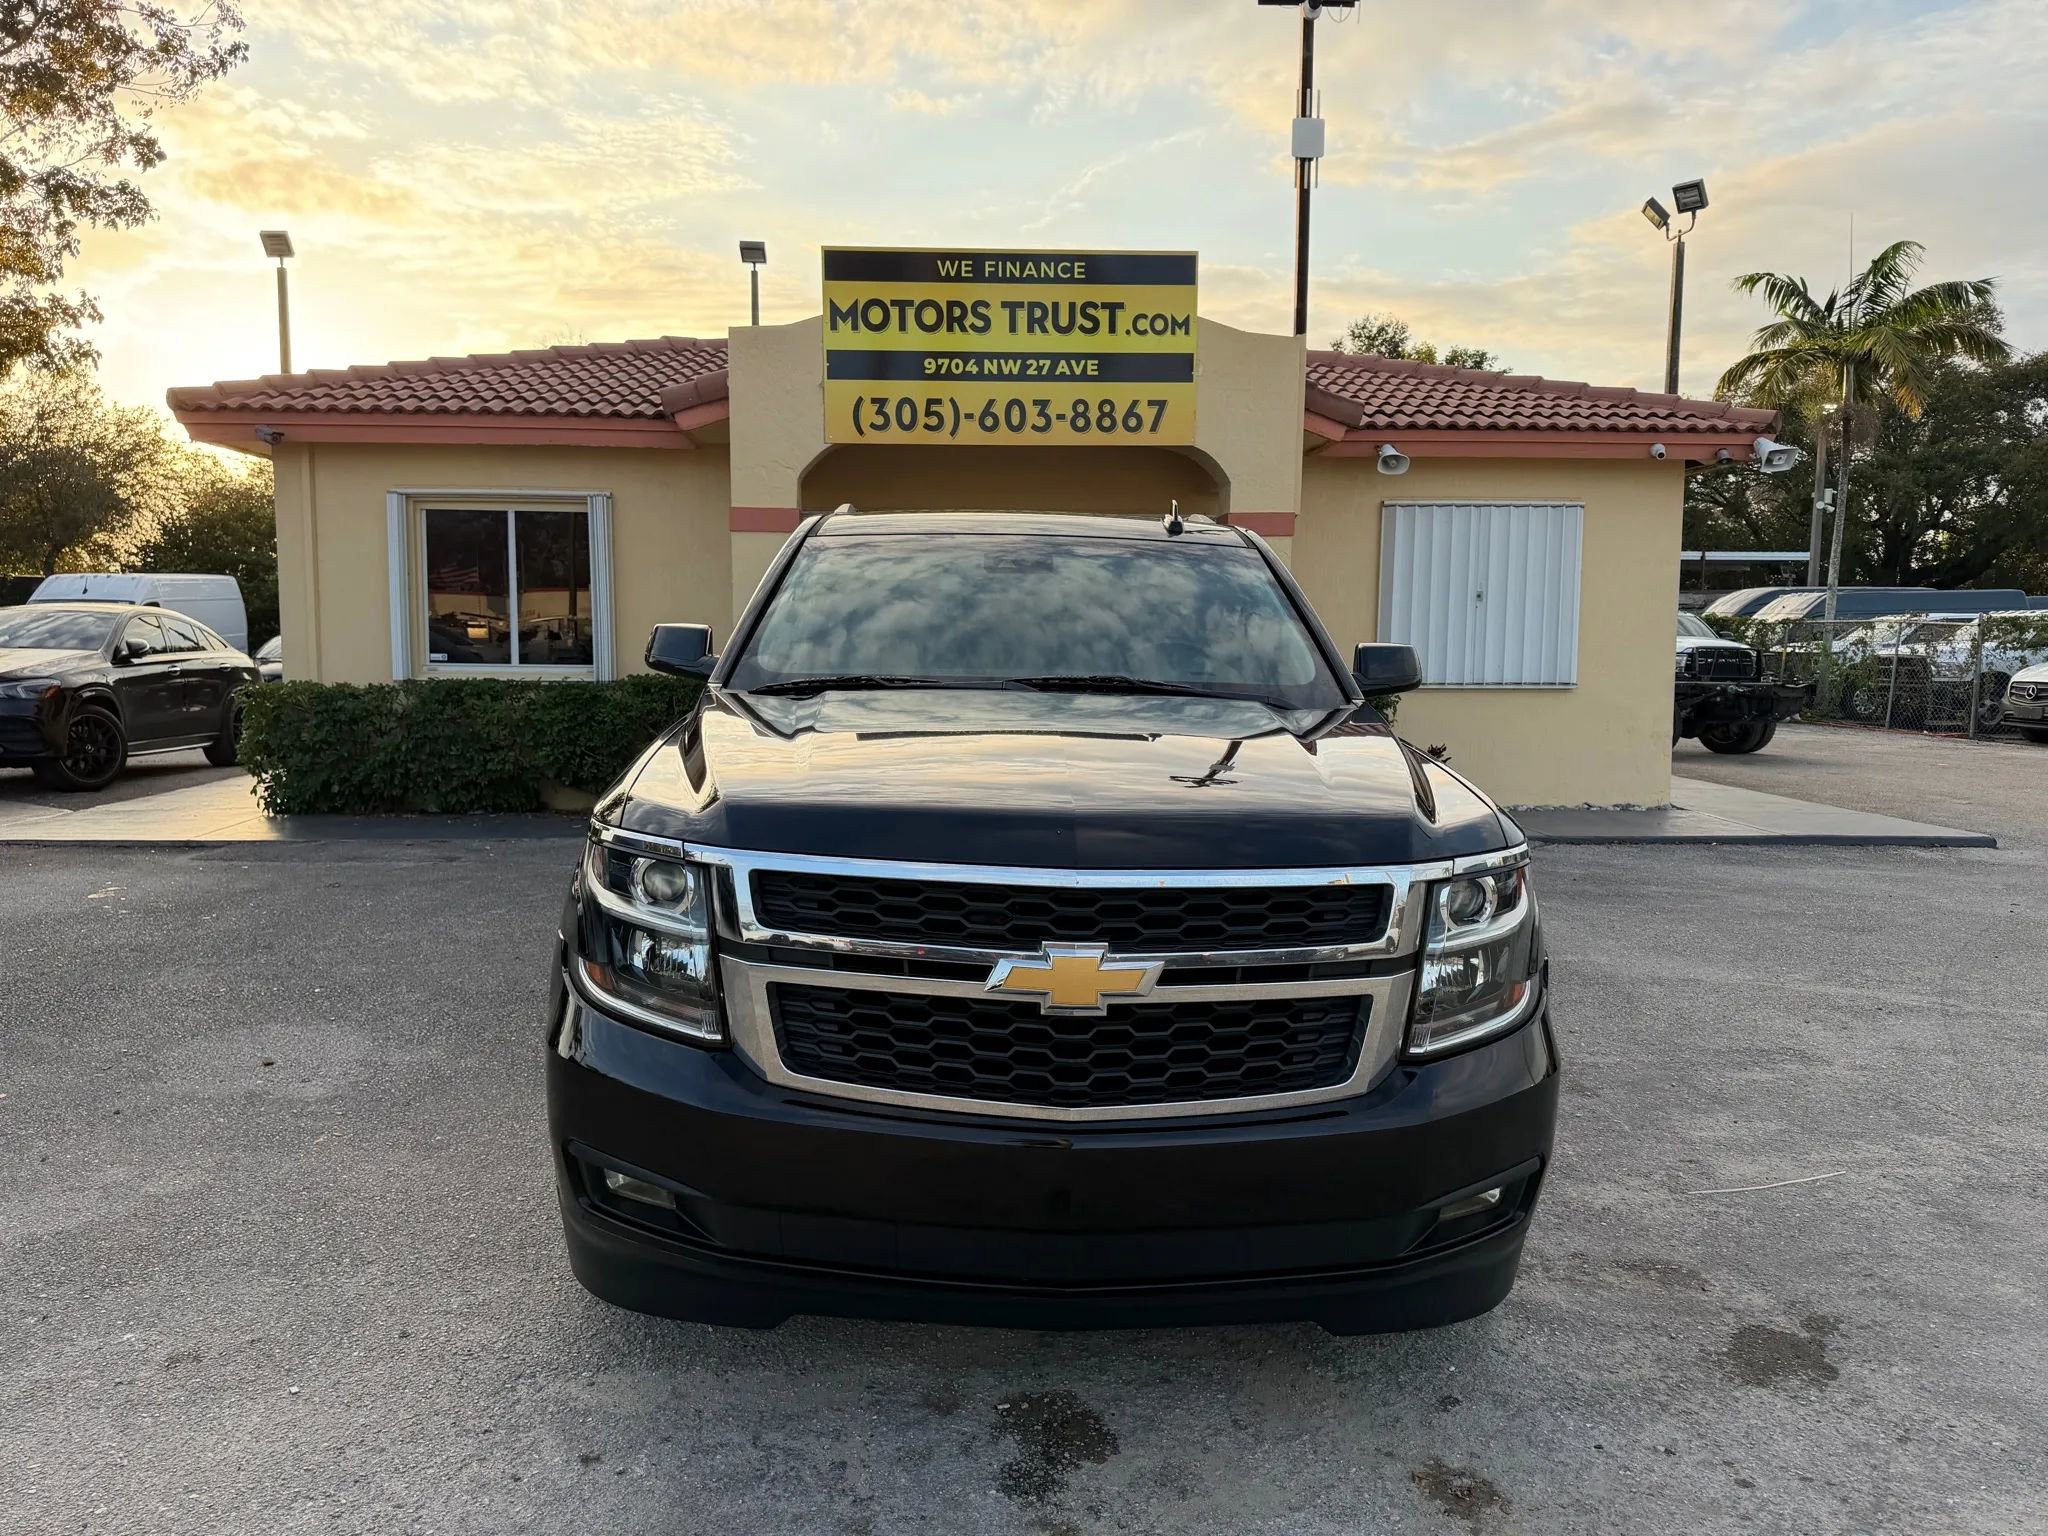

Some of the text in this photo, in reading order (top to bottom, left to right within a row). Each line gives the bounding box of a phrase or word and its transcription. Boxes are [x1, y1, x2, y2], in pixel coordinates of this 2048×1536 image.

[936, 259, 1087, 279] WE FINANCE
[829, 297, 1191, 337] MOTORS TRUST.COM
[923, 357, 1099, 376] 9704 NW 27 AVE
[852, 395, 1169, 439] (305)-603-8867
